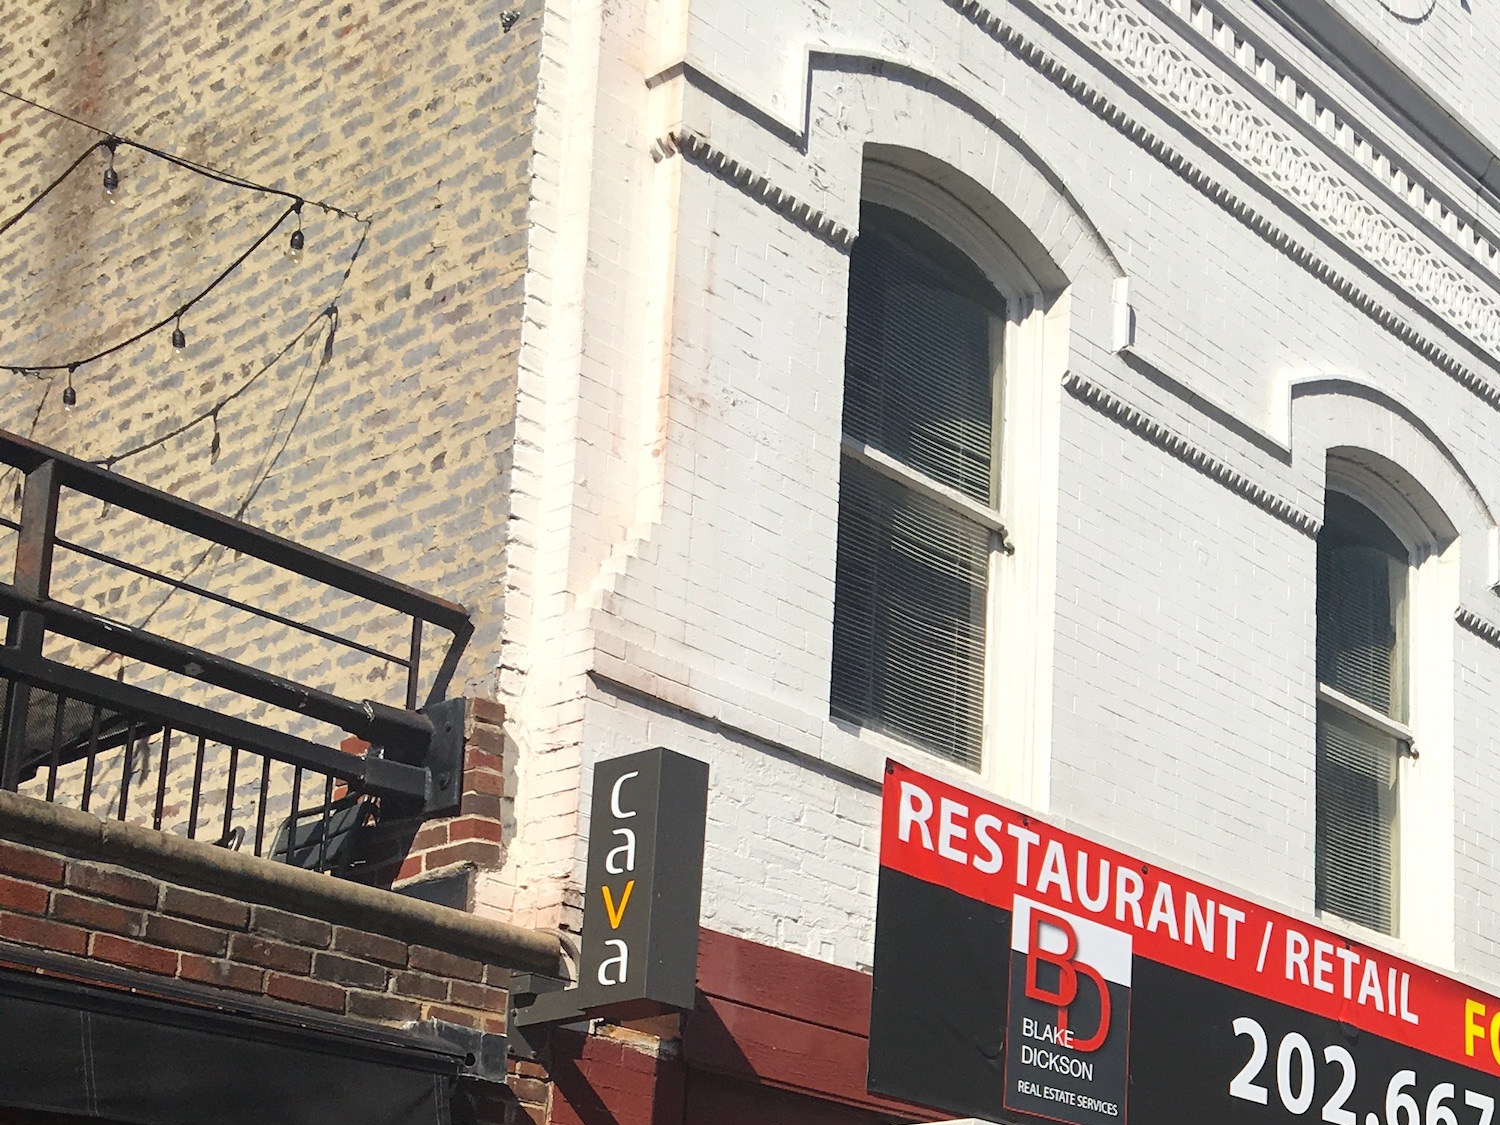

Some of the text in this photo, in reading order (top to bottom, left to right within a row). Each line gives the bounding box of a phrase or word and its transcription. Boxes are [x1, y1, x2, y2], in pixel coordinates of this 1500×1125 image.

[597, 771, 639, 986] cava
[898, 780, 1246, 961] RESTAURANT
[1256, 921, 1274, 972] /
[1285, 929, 1419, 1025] RETAIL
[1022, 1017, 1074, 1049] BLAKE
[1021, 1045, 1093, 1081] DICKSON
[1018, 1080, 1118, 1116] REAL ESTATE SERVICES
